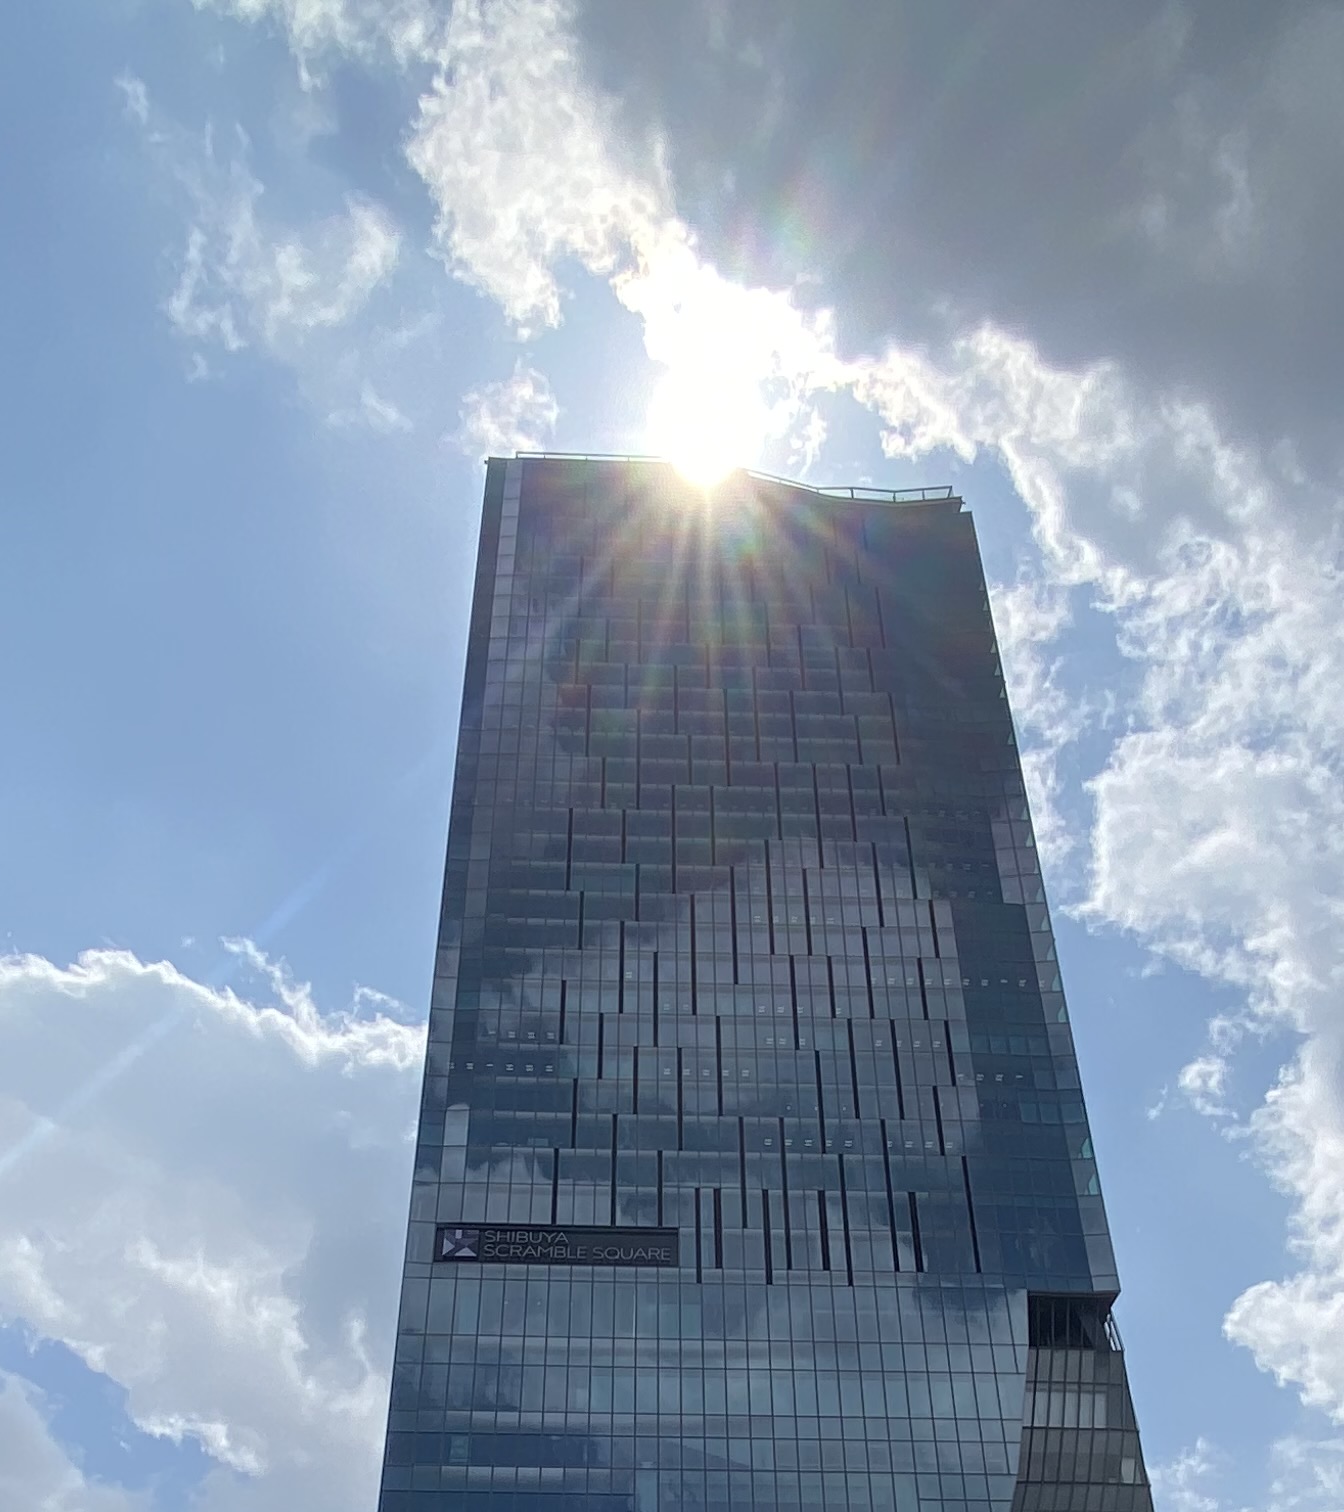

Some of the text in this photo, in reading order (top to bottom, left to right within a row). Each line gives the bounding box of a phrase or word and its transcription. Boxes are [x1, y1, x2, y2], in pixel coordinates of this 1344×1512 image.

[484, 1230, 569, 1244] SHIBUYA
[483, 1244, 671, 1261] SCRAMBLE SQUARE
